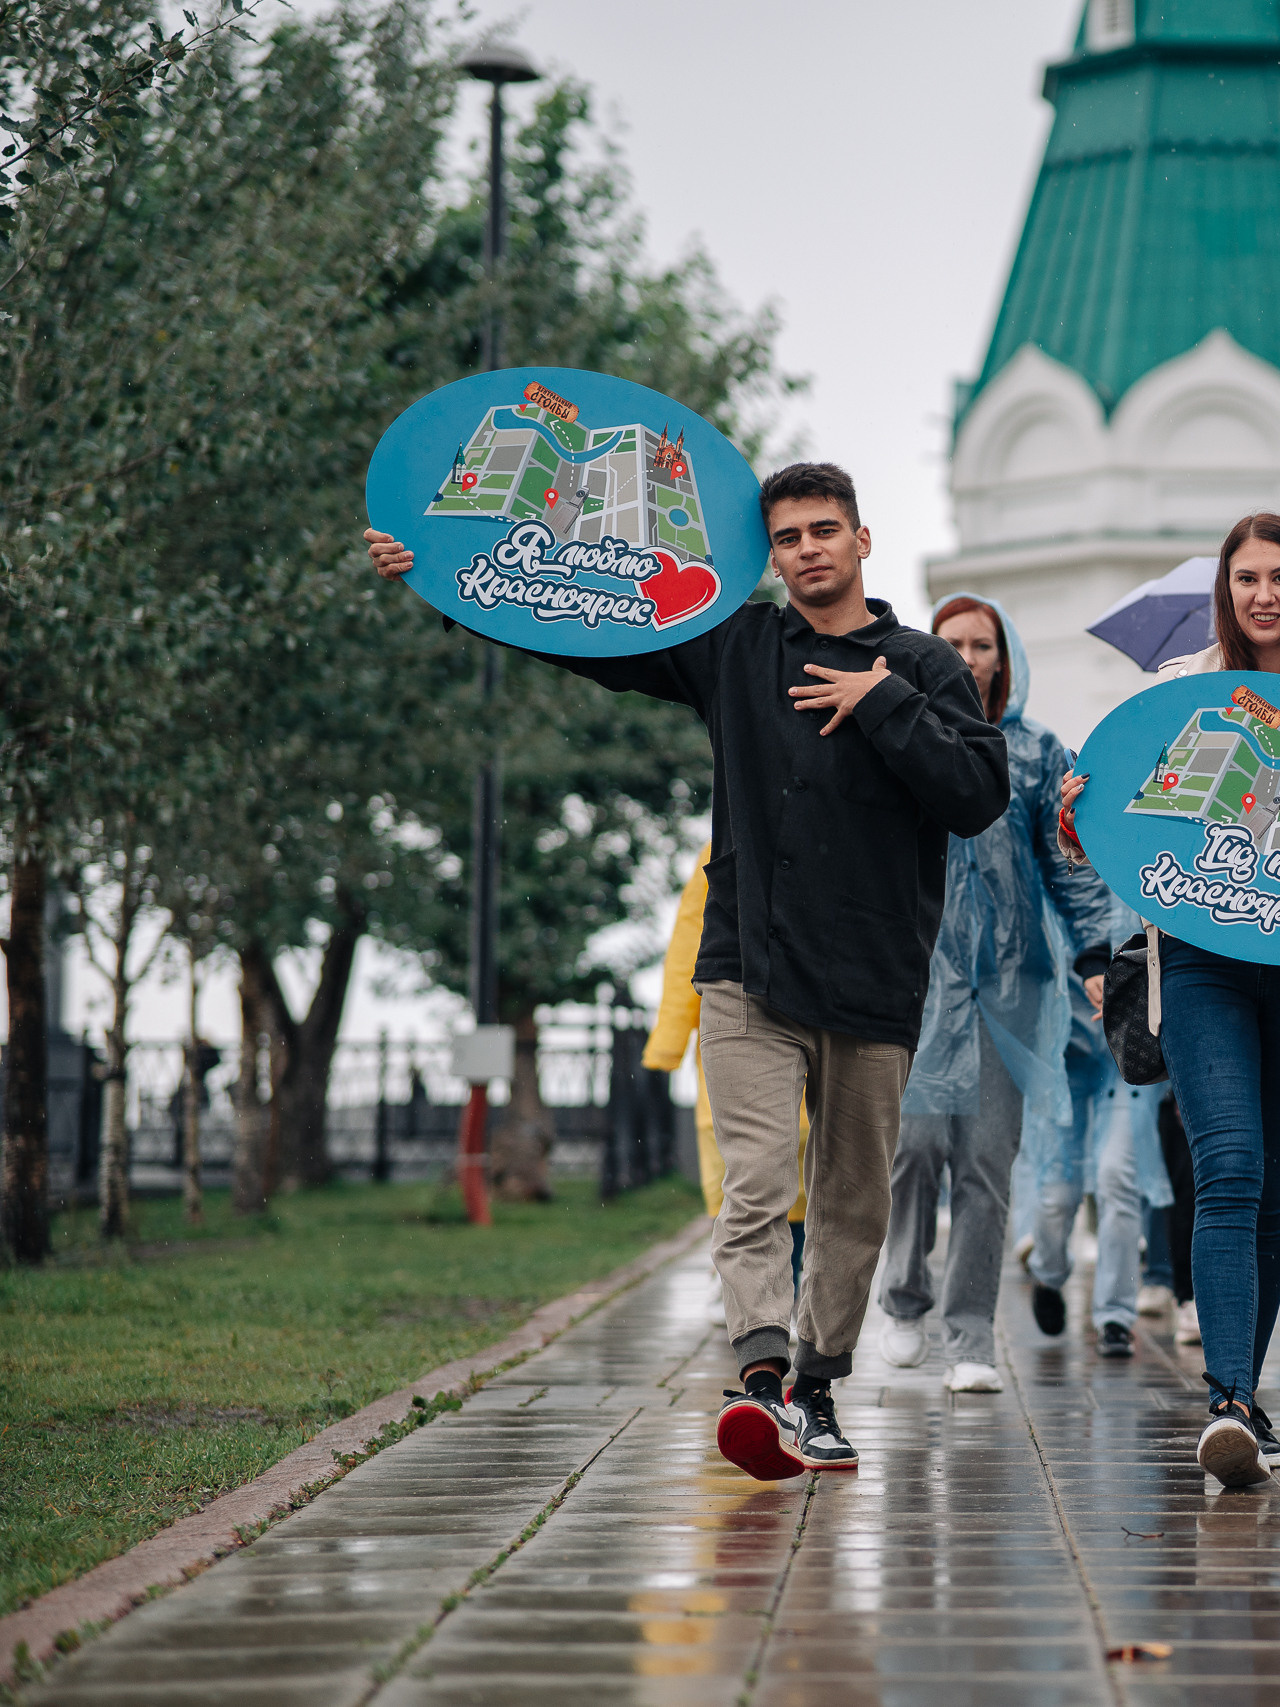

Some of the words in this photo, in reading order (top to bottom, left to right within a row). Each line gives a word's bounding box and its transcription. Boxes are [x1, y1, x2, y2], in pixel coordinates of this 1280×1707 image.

[530, 391, 571, 420] СТОЛБЫ
[495, 521, 574, 579] Я
[556, 538, 660, 579] люблю
[459, 556, 654, 627] Красноярск
[1236, 695, 1275, 725] СТОЛБЫ
[1196, 825, 1257, 882] Гид
